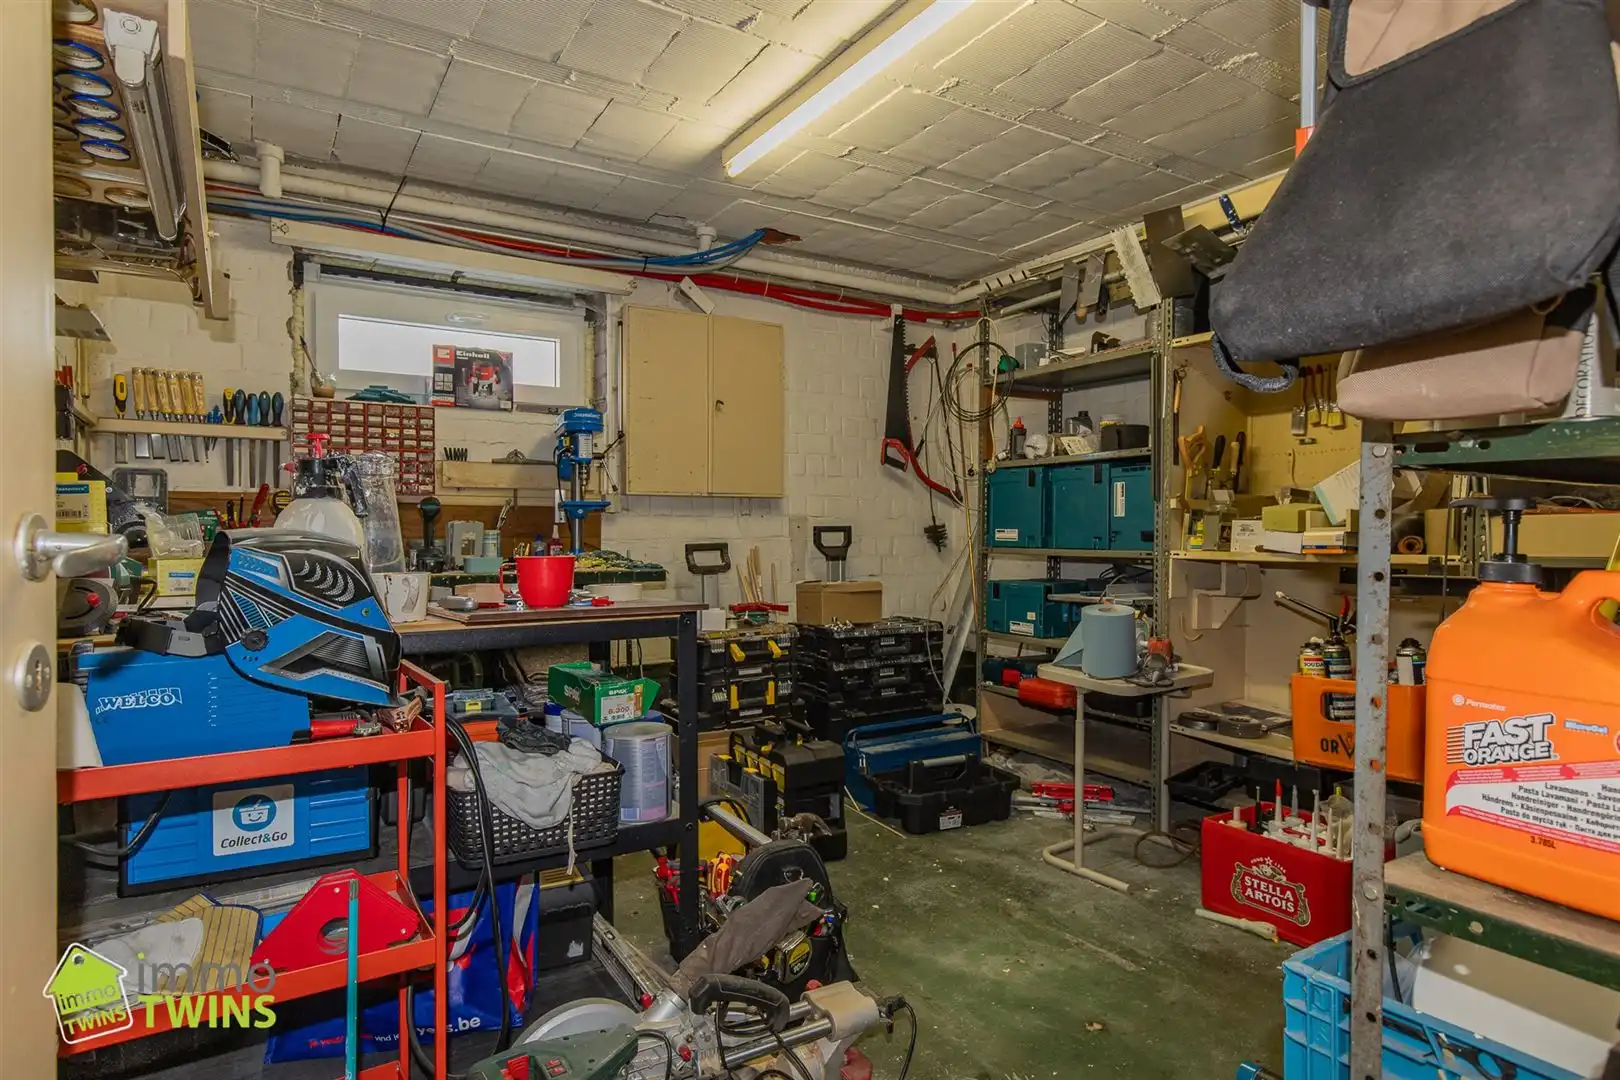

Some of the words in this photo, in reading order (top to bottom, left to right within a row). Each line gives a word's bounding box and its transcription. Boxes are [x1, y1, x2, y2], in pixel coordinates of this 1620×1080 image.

[456, 350, 490, 359] Einhell
[97, 688, 182, 713] WELCO
[1463, 713, 1555, 750] FAST
[1463, 741, 1553, 766] ORANGE
[1511, 792, 1559, 809] Handreiniger
[1518, 785, 1539, 796] Pasta
[1587, 799, 1611, 810] Pasta
[1501, 806, 1520, 817] Pasta
[221, 831, 288, 849] Collect&Go
[1244, 875, 1295, 902] STELLA
[1244, 887, 1295, 913] ARTOIS
